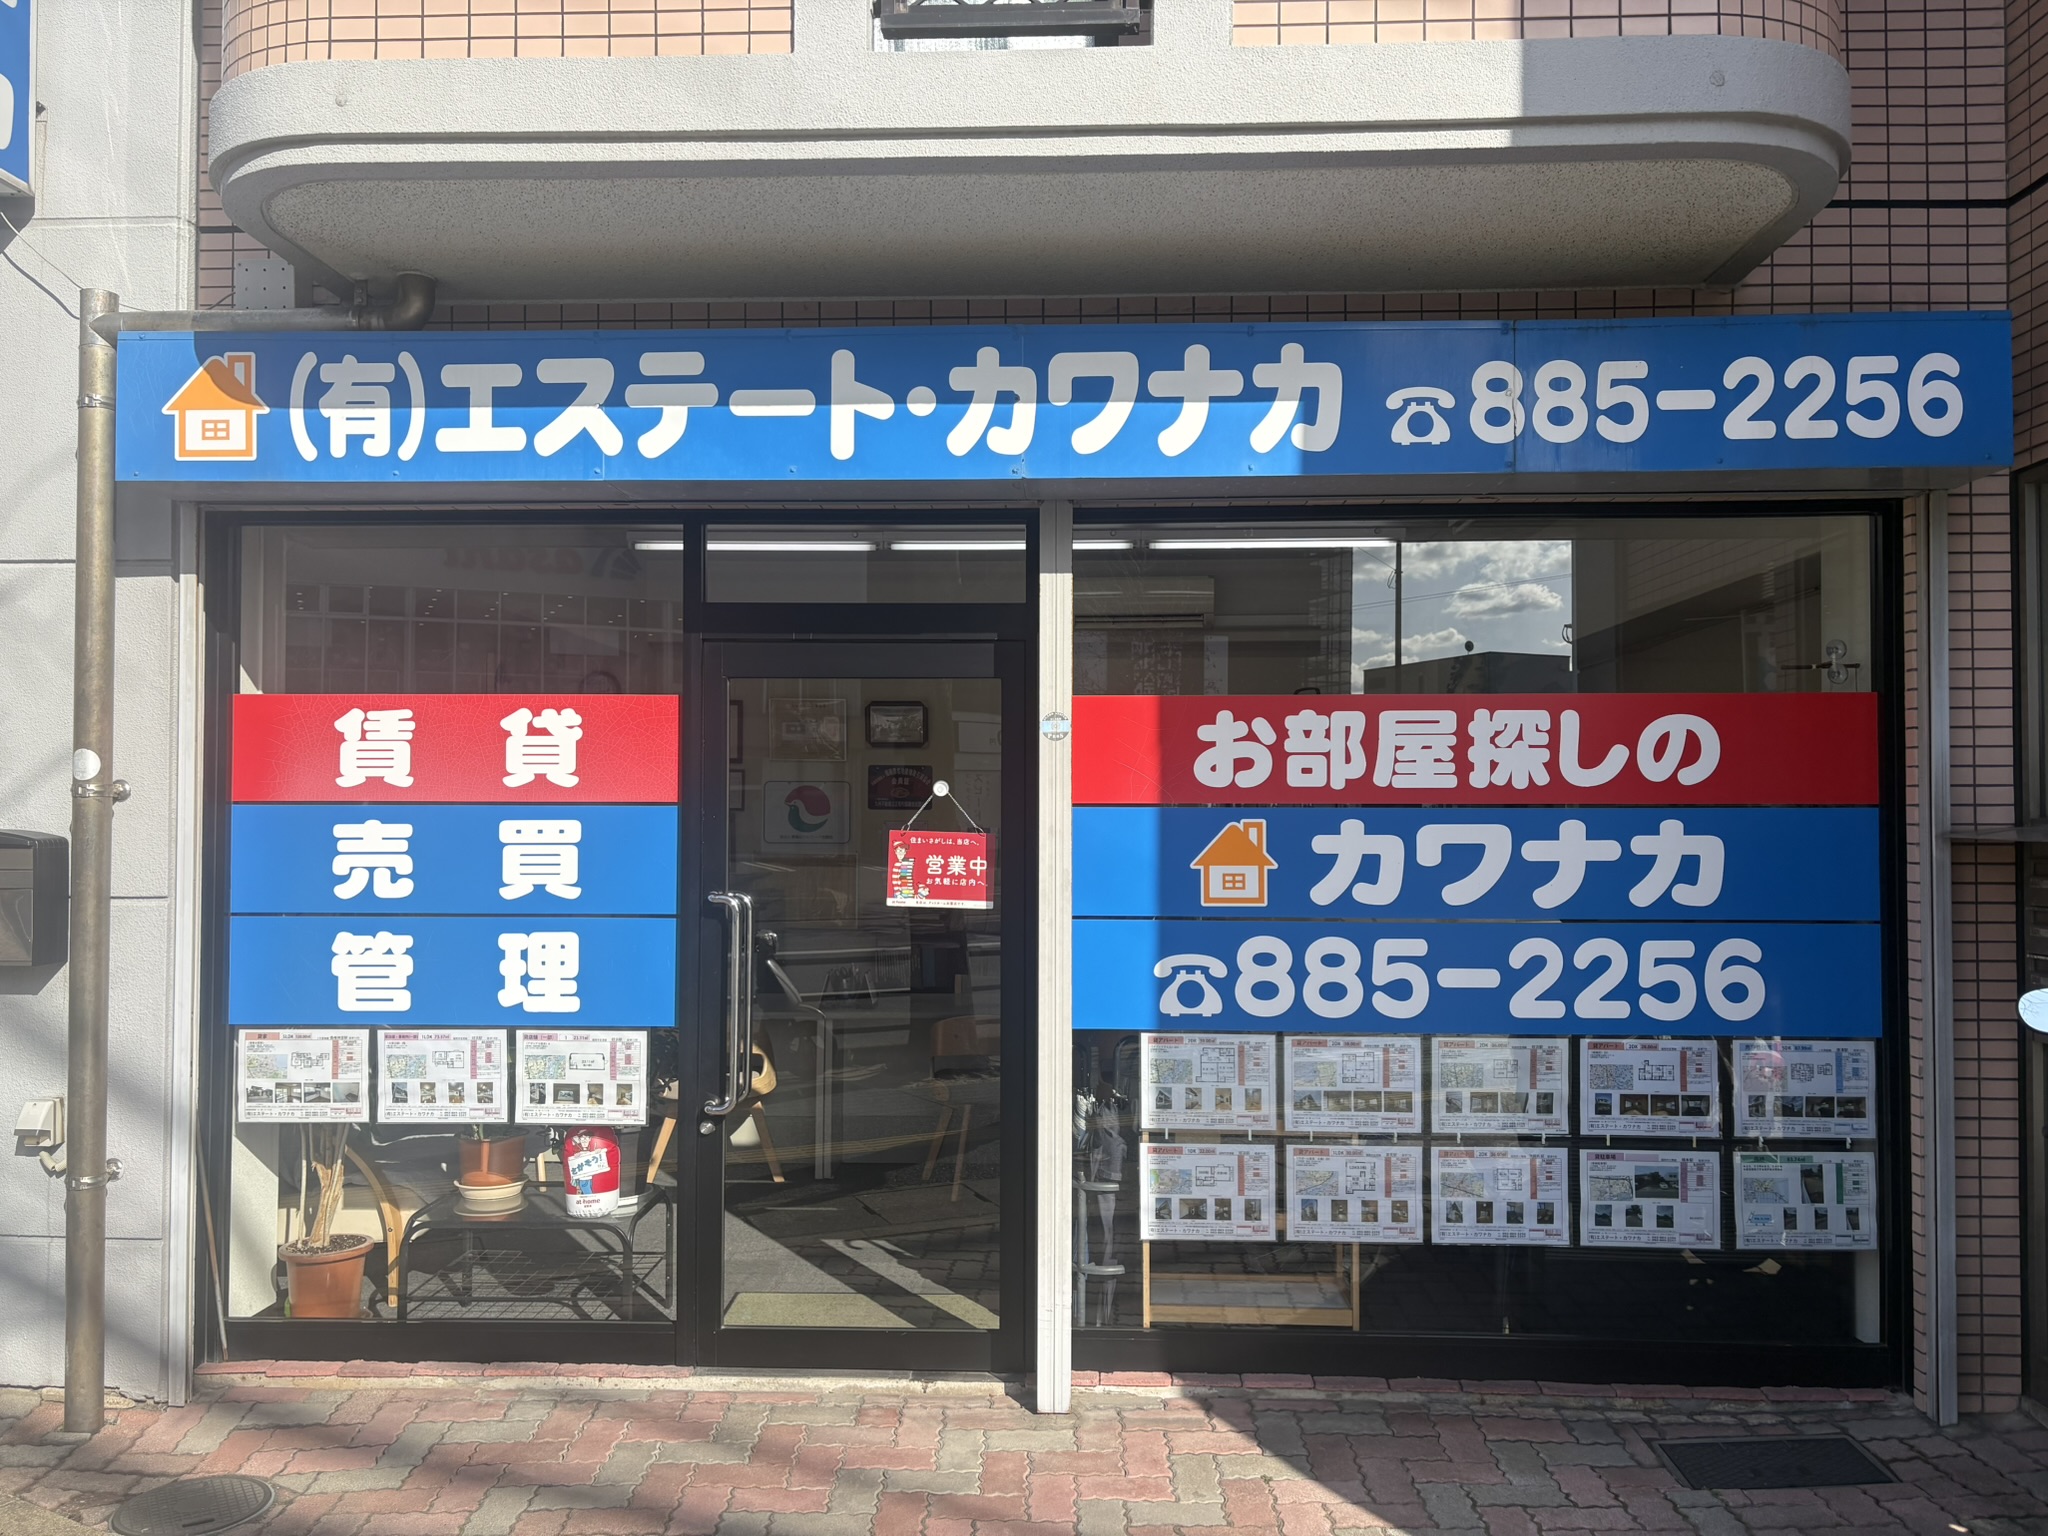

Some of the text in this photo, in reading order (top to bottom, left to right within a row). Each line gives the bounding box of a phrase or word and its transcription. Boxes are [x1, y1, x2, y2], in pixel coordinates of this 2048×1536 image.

[290, 343, 1963, 463] (有)エステート・カワナカ 885-2256
[334, 708, 583, 788] 賃貸
[1193, 709, 1721, 790] お部屋探しの
[332, 819, 582, 900] 売買
[925, 854, 988, 877] 営業中
[1310, 819, 1725, 909] カワナカ
[331, 931, 581, 1013] 管理
[1234, 935, 1766, 1021] 885-2256
